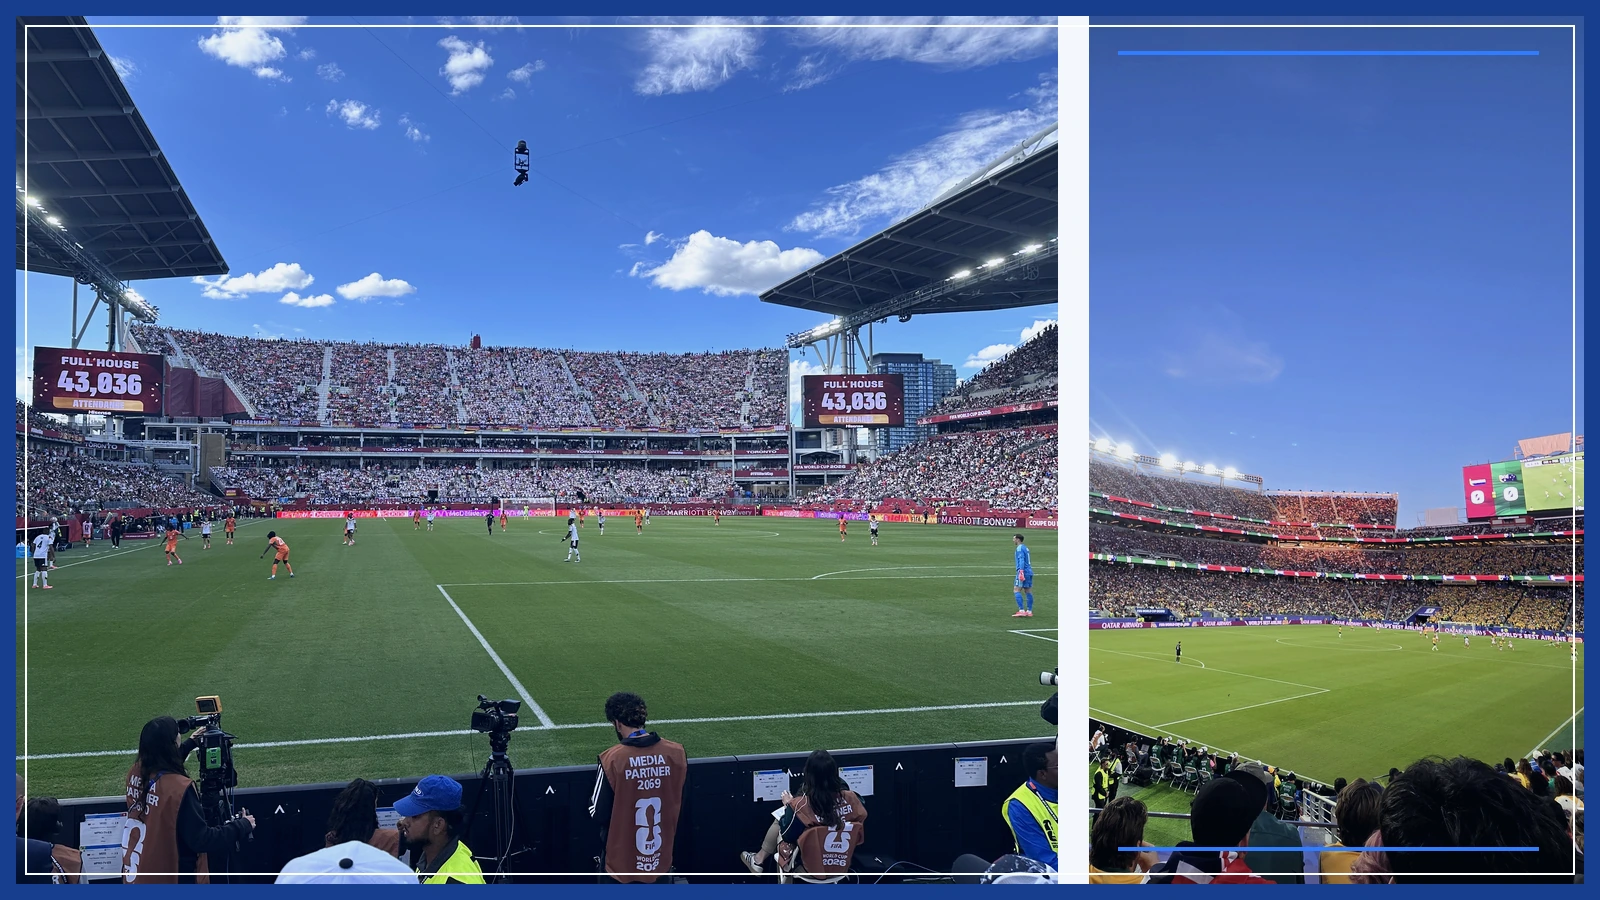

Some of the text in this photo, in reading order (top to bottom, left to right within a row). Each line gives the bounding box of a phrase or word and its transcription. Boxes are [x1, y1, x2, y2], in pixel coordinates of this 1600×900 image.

[61, 356, 139, 369] FULL HOUSE
[57, 370, 142, 397] 43,036
[821, 392, 887, 413] 43,036
[941, 517, 980, 525] MARRIOTT
[37, 541, 43, 549] 4
[629, 754, 666, 768] MEDIA
[625, 766, 671, 780] PARTNER
[130, 775, 156, 793] MEA
[637, 778, 661, 790] 2069
[127, 786, 159, 806] ARER
[822, 859, 847, 867] 2026
